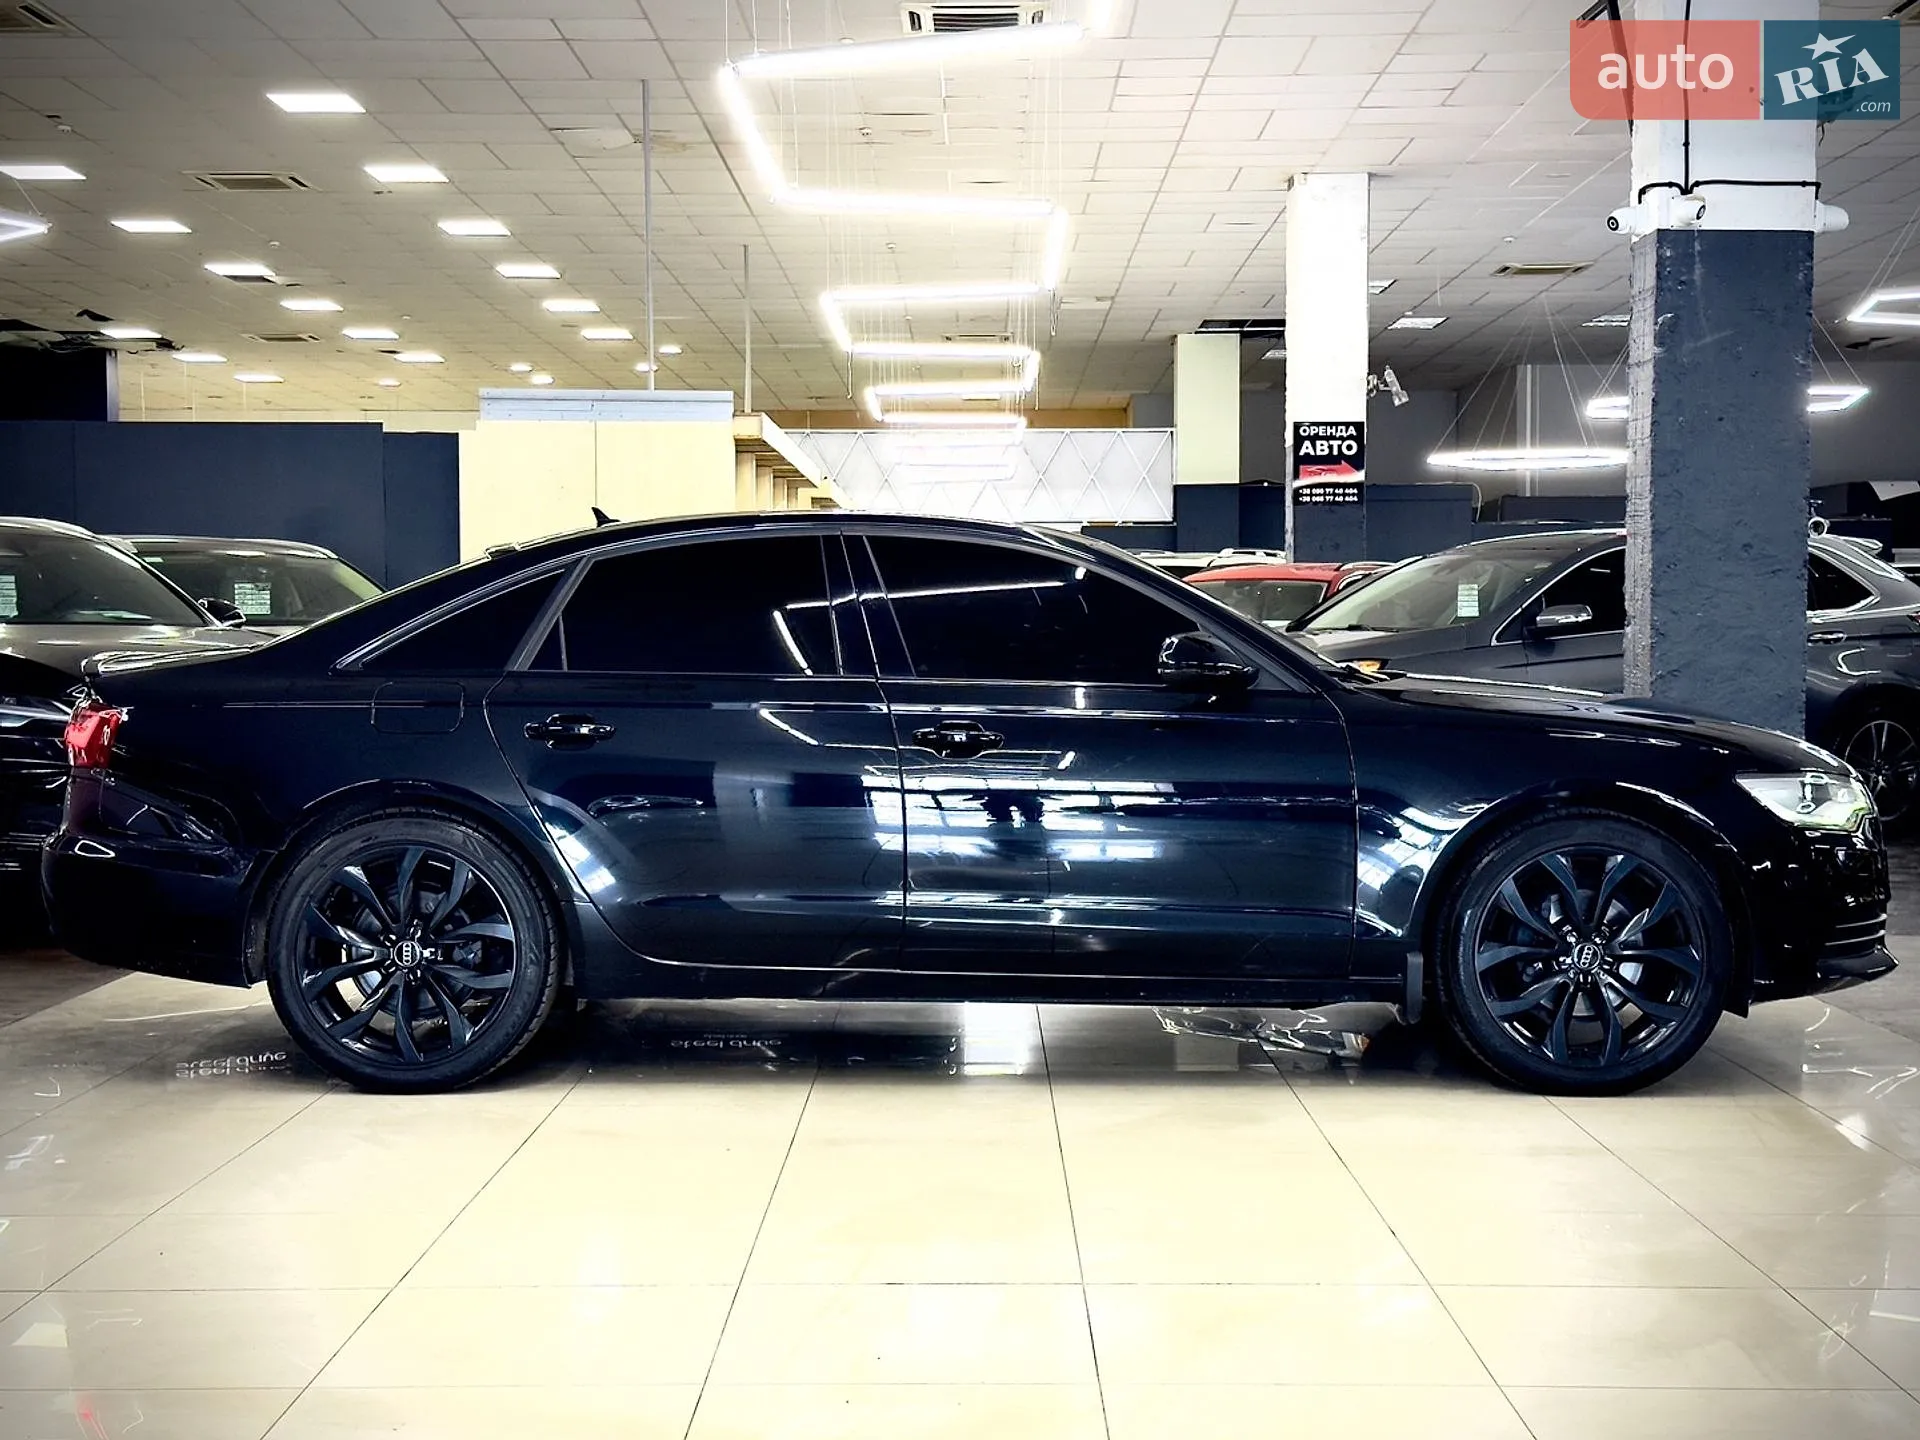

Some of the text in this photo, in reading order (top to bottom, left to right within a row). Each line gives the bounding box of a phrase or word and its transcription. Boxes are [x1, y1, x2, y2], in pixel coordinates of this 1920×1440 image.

[1299, 425, 1357, 438] ОРЕНДА
[1298, 440, 1358, 456] АВТО
[1325, 487, 1335, 495] 77
[1325, 495, 1335, 503] 77
